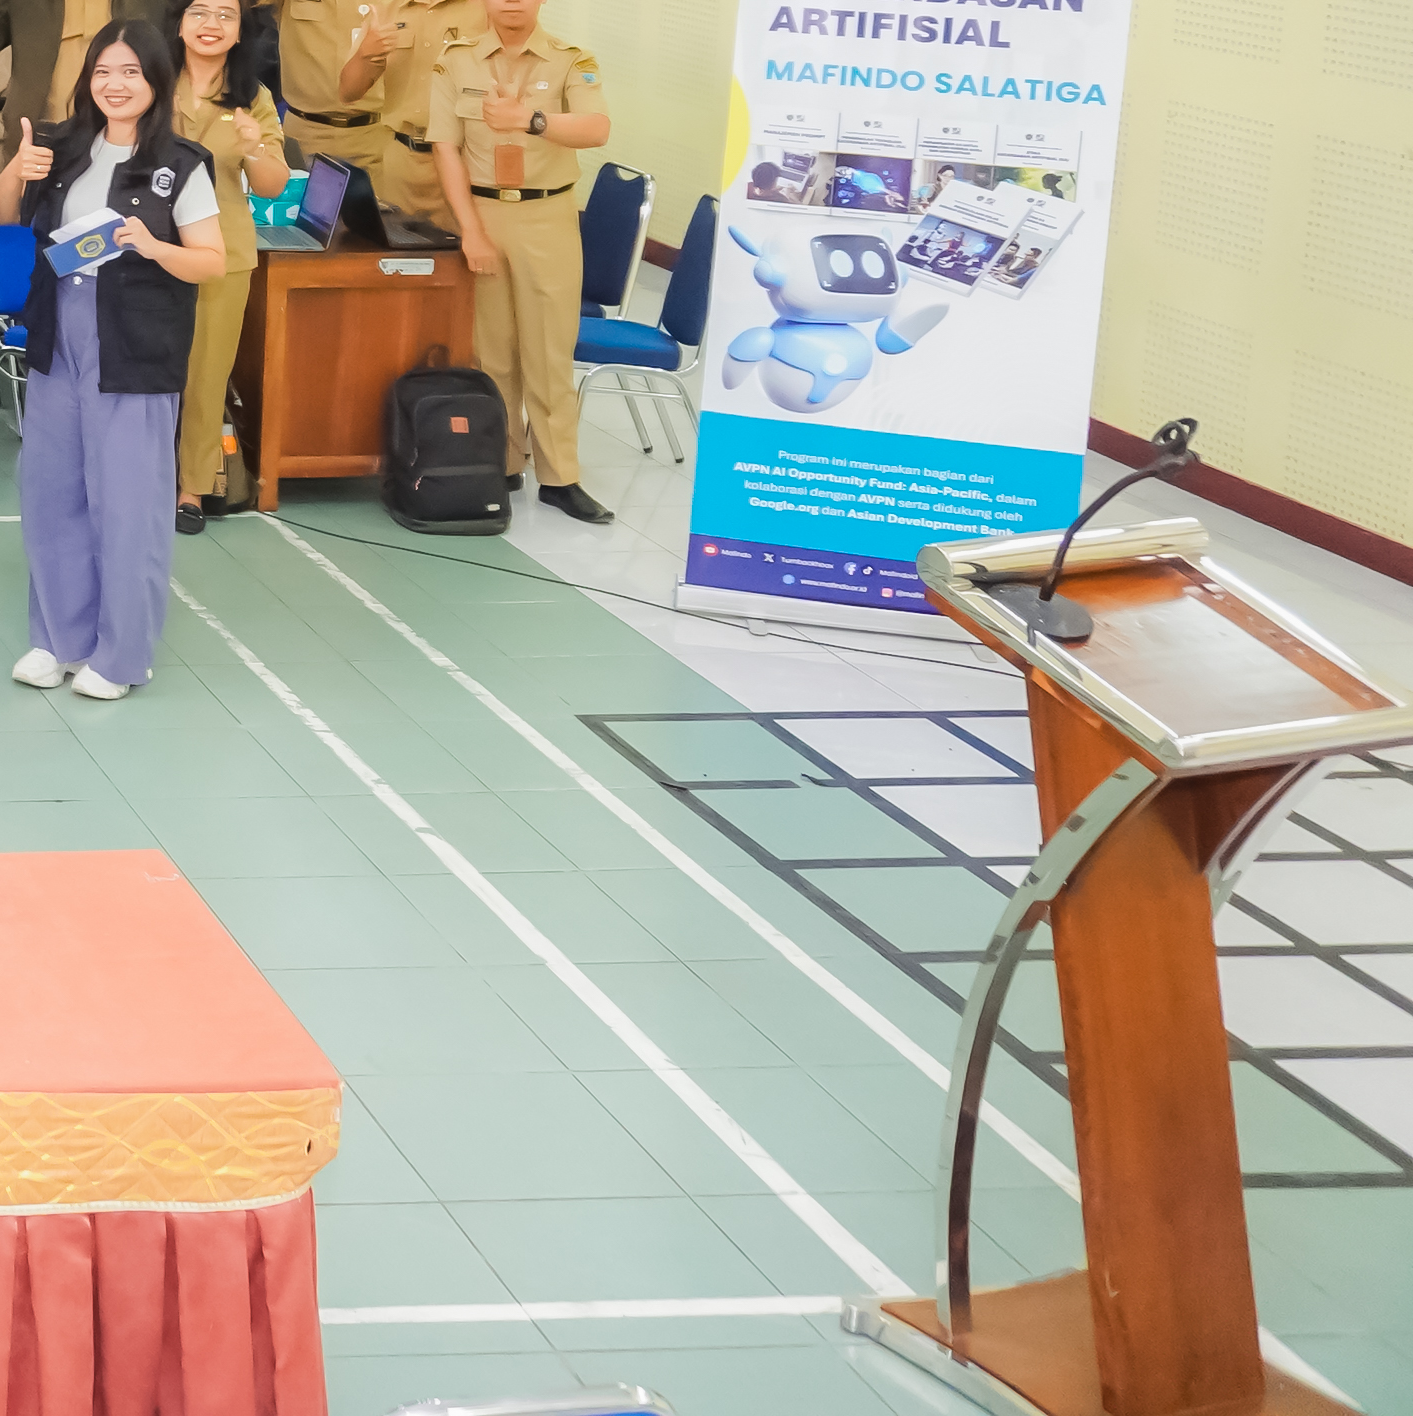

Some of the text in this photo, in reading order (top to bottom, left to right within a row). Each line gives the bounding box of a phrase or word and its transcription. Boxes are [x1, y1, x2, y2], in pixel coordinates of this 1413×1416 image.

[769, 5, 1011, 48] ARTIFISIAL
[765, 59, 1107, 106] MAFINDO SALATIGA
[733, 461, 1037, 507] AVPN AI Opportunity Fund: Asia-Pacific, dalam
[778, 449, 995, 484] Program ini merupakan bagian dari
[743, 479, 1023, 522] kolaborasi dengan AVPN serta didukung oleh
[749, 496, 820, 516] Google.org
[821, 505, 846, 517] dan
[847, 508, 885, 522] Asian
[887, 513, 978, 534] Development
